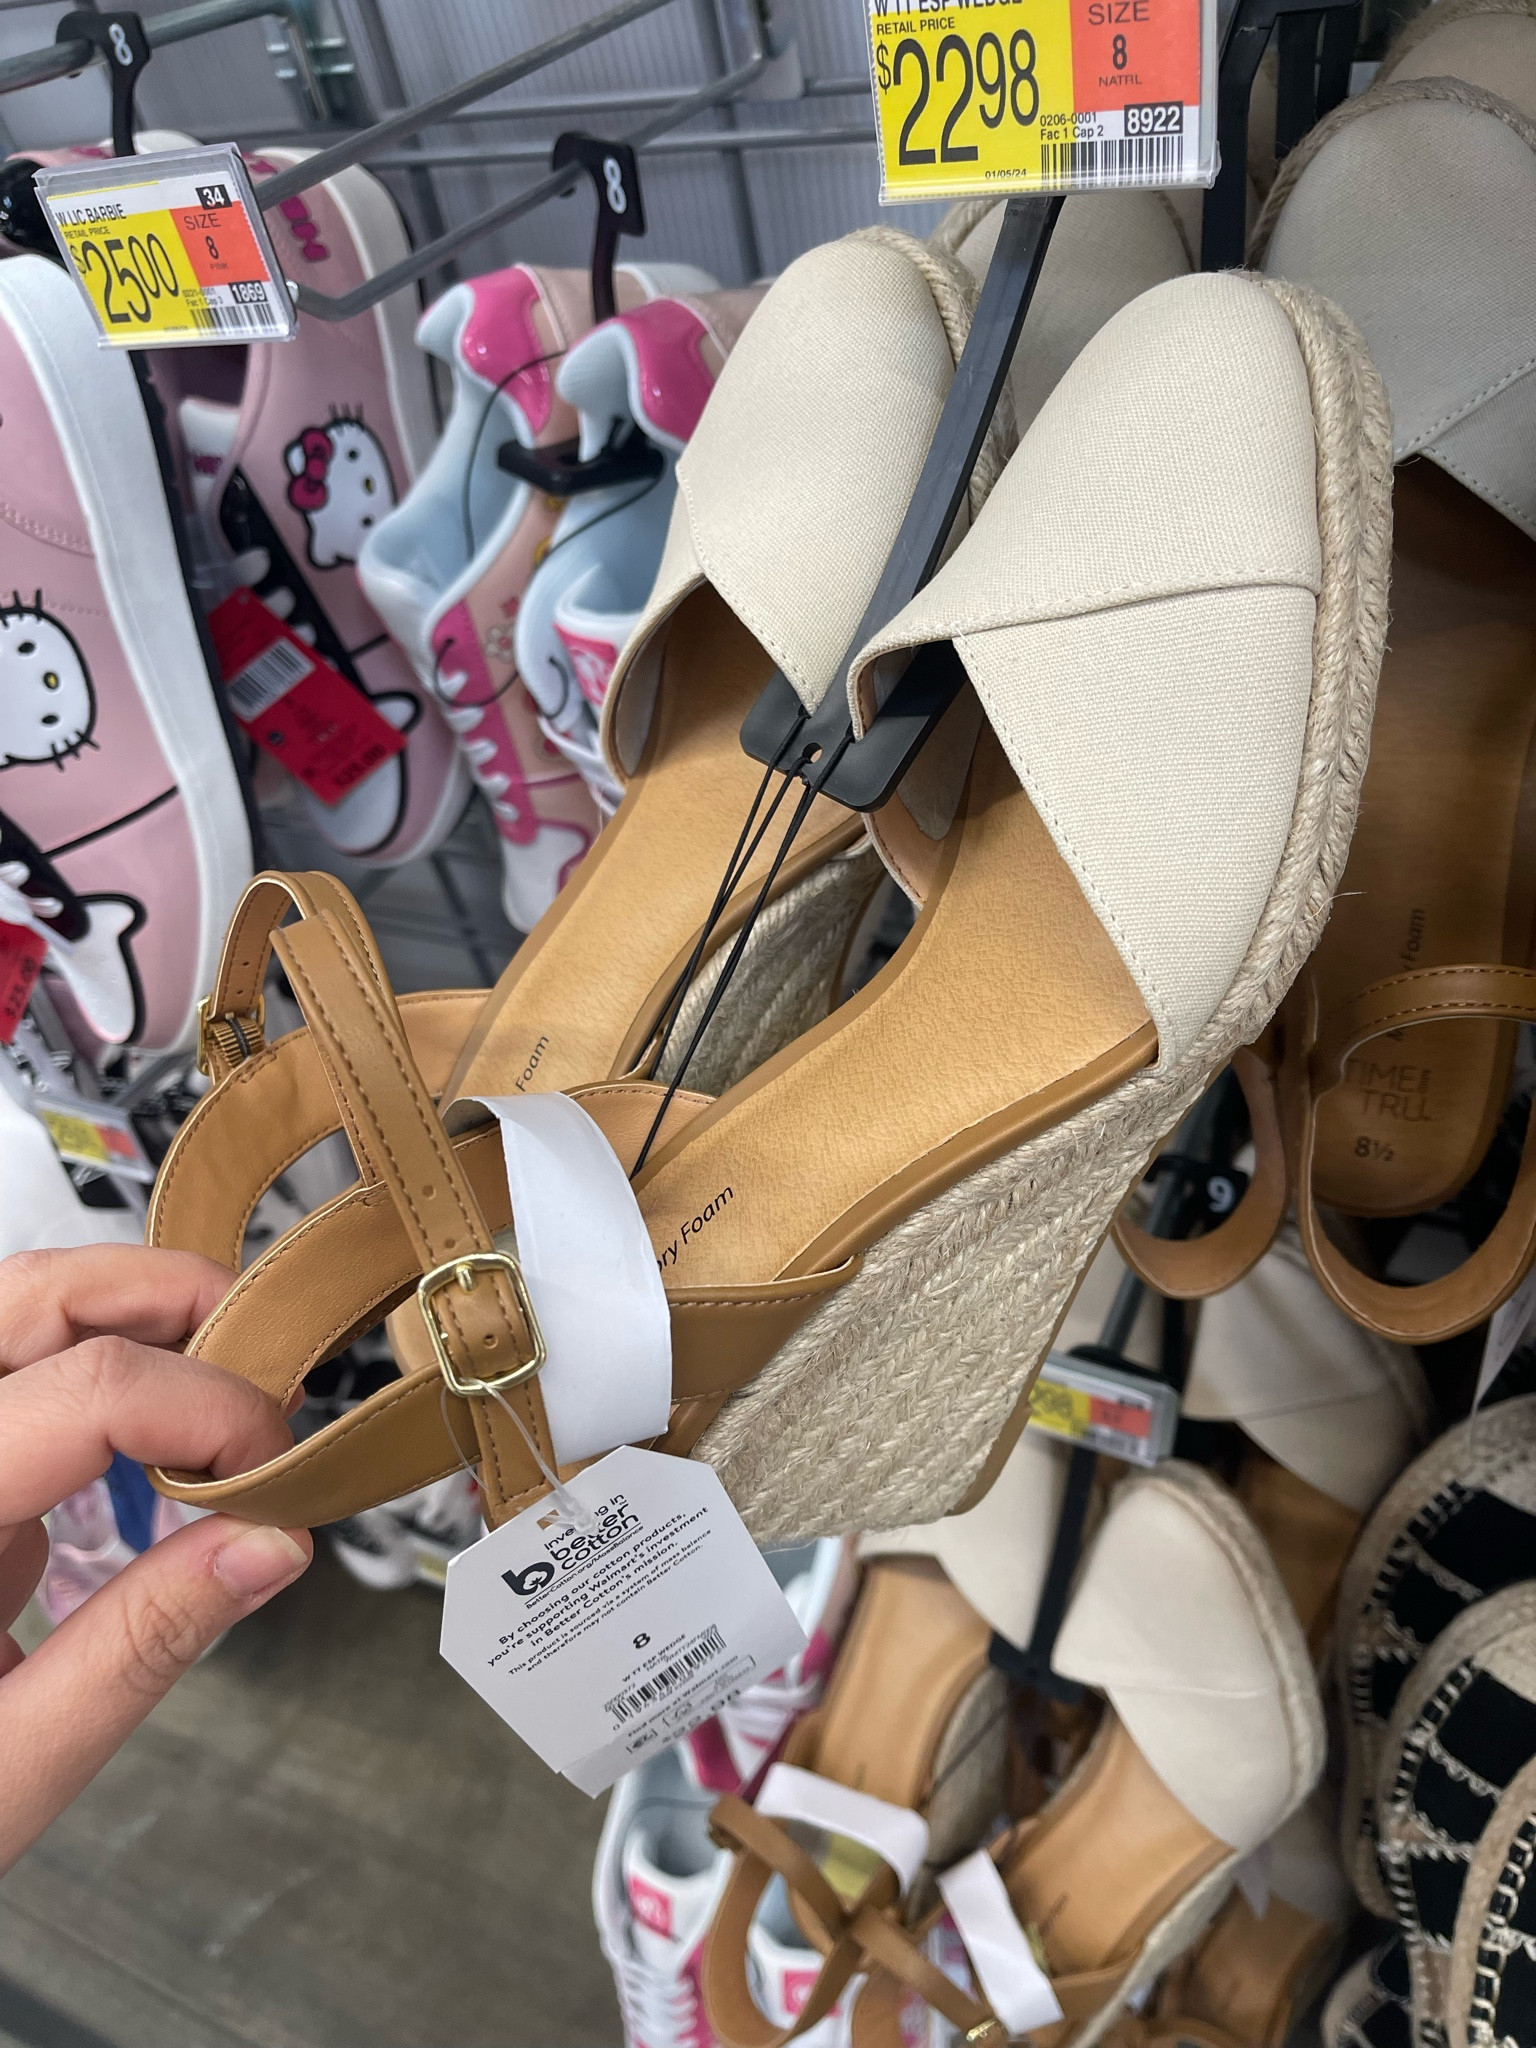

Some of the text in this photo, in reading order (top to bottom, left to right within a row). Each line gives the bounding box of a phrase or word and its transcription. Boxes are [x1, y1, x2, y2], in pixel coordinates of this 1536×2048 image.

[877, 17, 955, 35] RETAIL PRICE
[1088, 2, 1150, 26] SIZE
[108, 22, 134, 66] 8
[1112, 34, 1128, 70] 8
[1098, 74, 1142, 87] NATRL
[1040, 111, 1097, 127] 0206-0001
[1040, 125, 1104, 140] Fac 1 Cap 2
[1127, 105, 1181, 135] 8922
[602, 157, 627, 215] 8
[985, 168, 1027, 180] 01/05/24
[202, 187, 225, 208] 34
[55, 203, 127, 227] W LIC BARBIE
[183, 213, 222, 230] SIZE
[205, 235, 219, 260] 8
[231, 282, 266, 303] 1869
[515, 1035, 550, 1092] Foam
[1206, 1176, 1235, 1213] 9
[681, 1186, 734, 1245] Foam
[561, 1514, 639, 1570] cotton
[488, 1507, 708, 1667] you're supporting Walmart's investment
[499, 1513, 686, 1645] By choosing our cotton products,
[508, 1662, 527, 1675] This
[528, 1638, 561, 1664] product
[570, 1608, 601, 1632] sourced
[602, 1599, 614, 1609] via
[621, 1574, 650, 1596] system
[650, 1565, 659, 1575] of
[661, 1551, 680, 1567] mass
[681, 1529, 711, 1552] balance
[531, 1542, 678, 1647] in Better Cotton's mission.
[527, 1658, 542, 1672] and
[543, 1631, 582, 1660] therefore
[583, 1618, 600, 1632] may
[601, 1606, 615, 1619] not
[616, 1585, 646, 1608] contain
[646, 1566, 672, 1586] Better
[632, 1632, 651, 1649] 8
